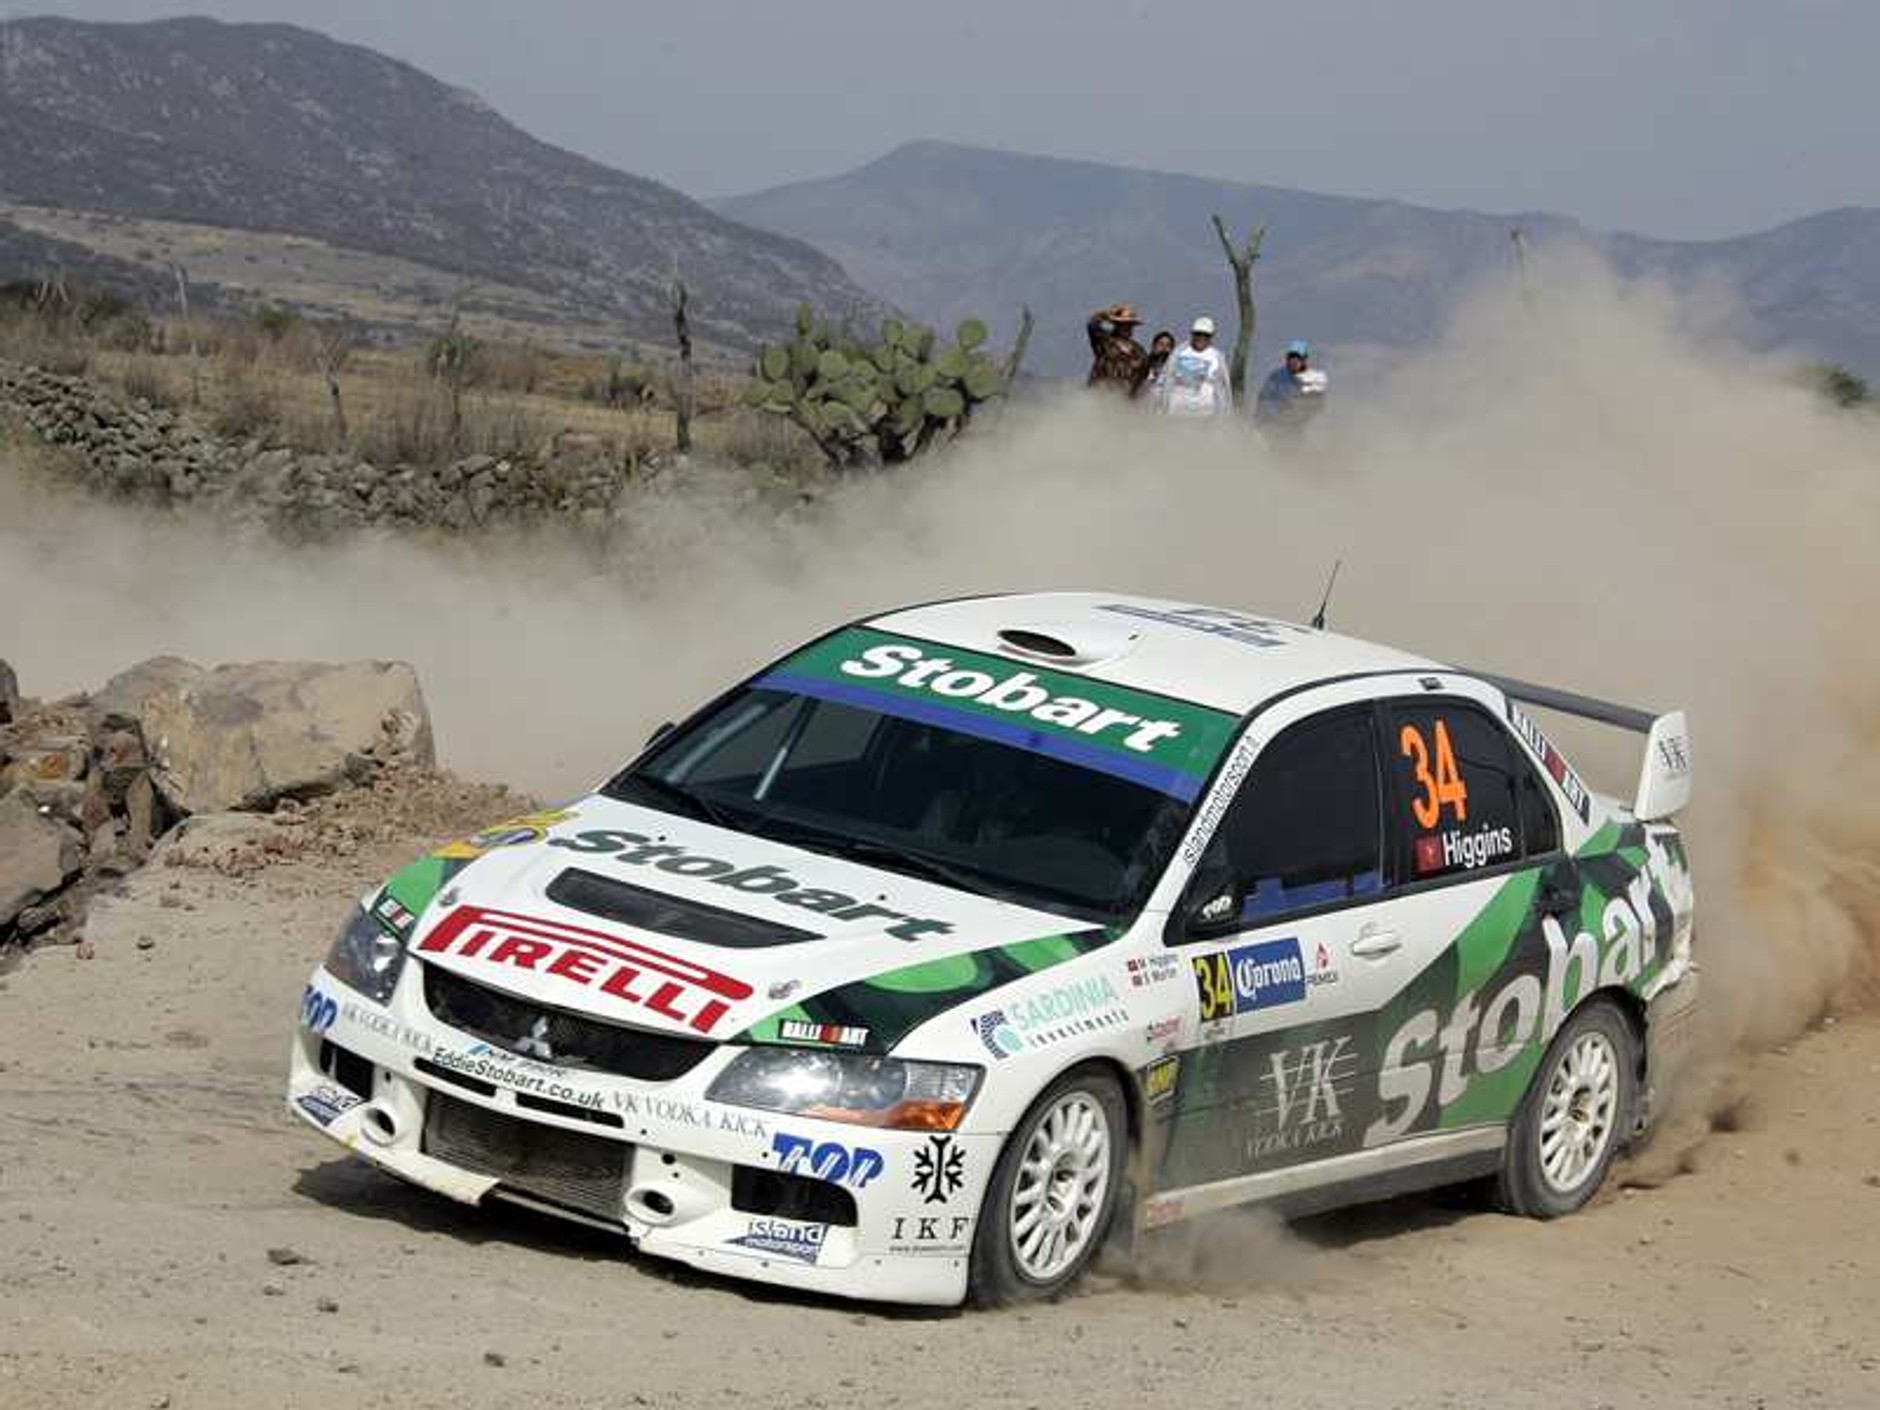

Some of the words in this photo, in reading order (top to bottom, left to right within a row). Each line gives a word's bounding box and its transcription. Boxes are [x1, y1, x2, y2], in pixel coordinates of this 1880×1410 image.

[838, 643, 1181, 754] Stobart
[1400, 717, 1468, 829] 34
[1442, 823, 1512, 868] Higgins
[548, 828, 956, 941] Stobart
[417, 904, 754, 1035] PIRELLI
[1194, 953, 1233, 1019] 34
[1235, 956, 1302, 1001] Corona
[431, 1046, 605, 1109] EddieStobart.co.uk
[772, 1132, 885, 1188] TOP
